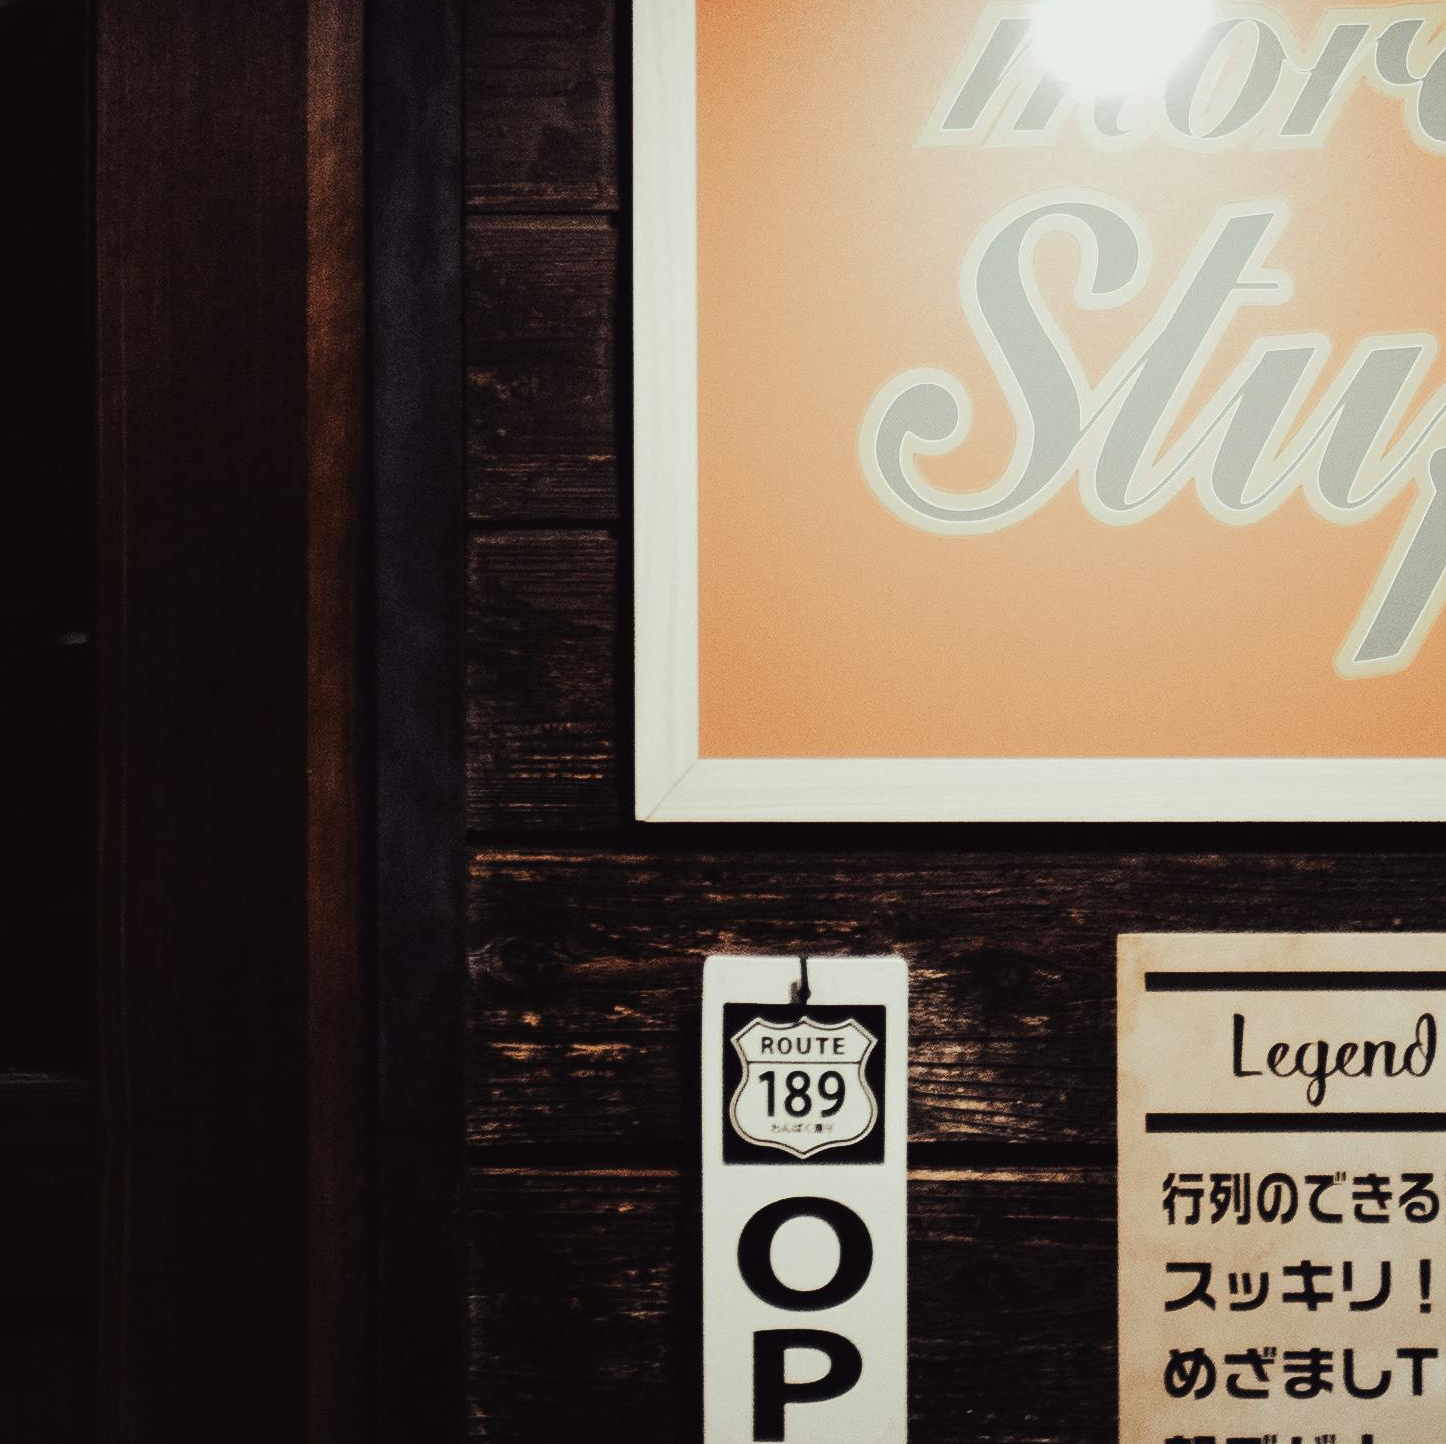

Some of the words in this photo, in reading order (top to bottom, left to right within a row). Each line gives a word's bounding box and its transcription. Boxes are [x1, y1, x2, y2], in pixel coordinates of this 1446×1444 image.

[761, 1037, 845, 1055] ROUTE
[1230, 1012, 1437, 1104] Legend
[758, 1070, 846, 1118] 189
[1163, 1257, 1434, 1314] スッキリ！
